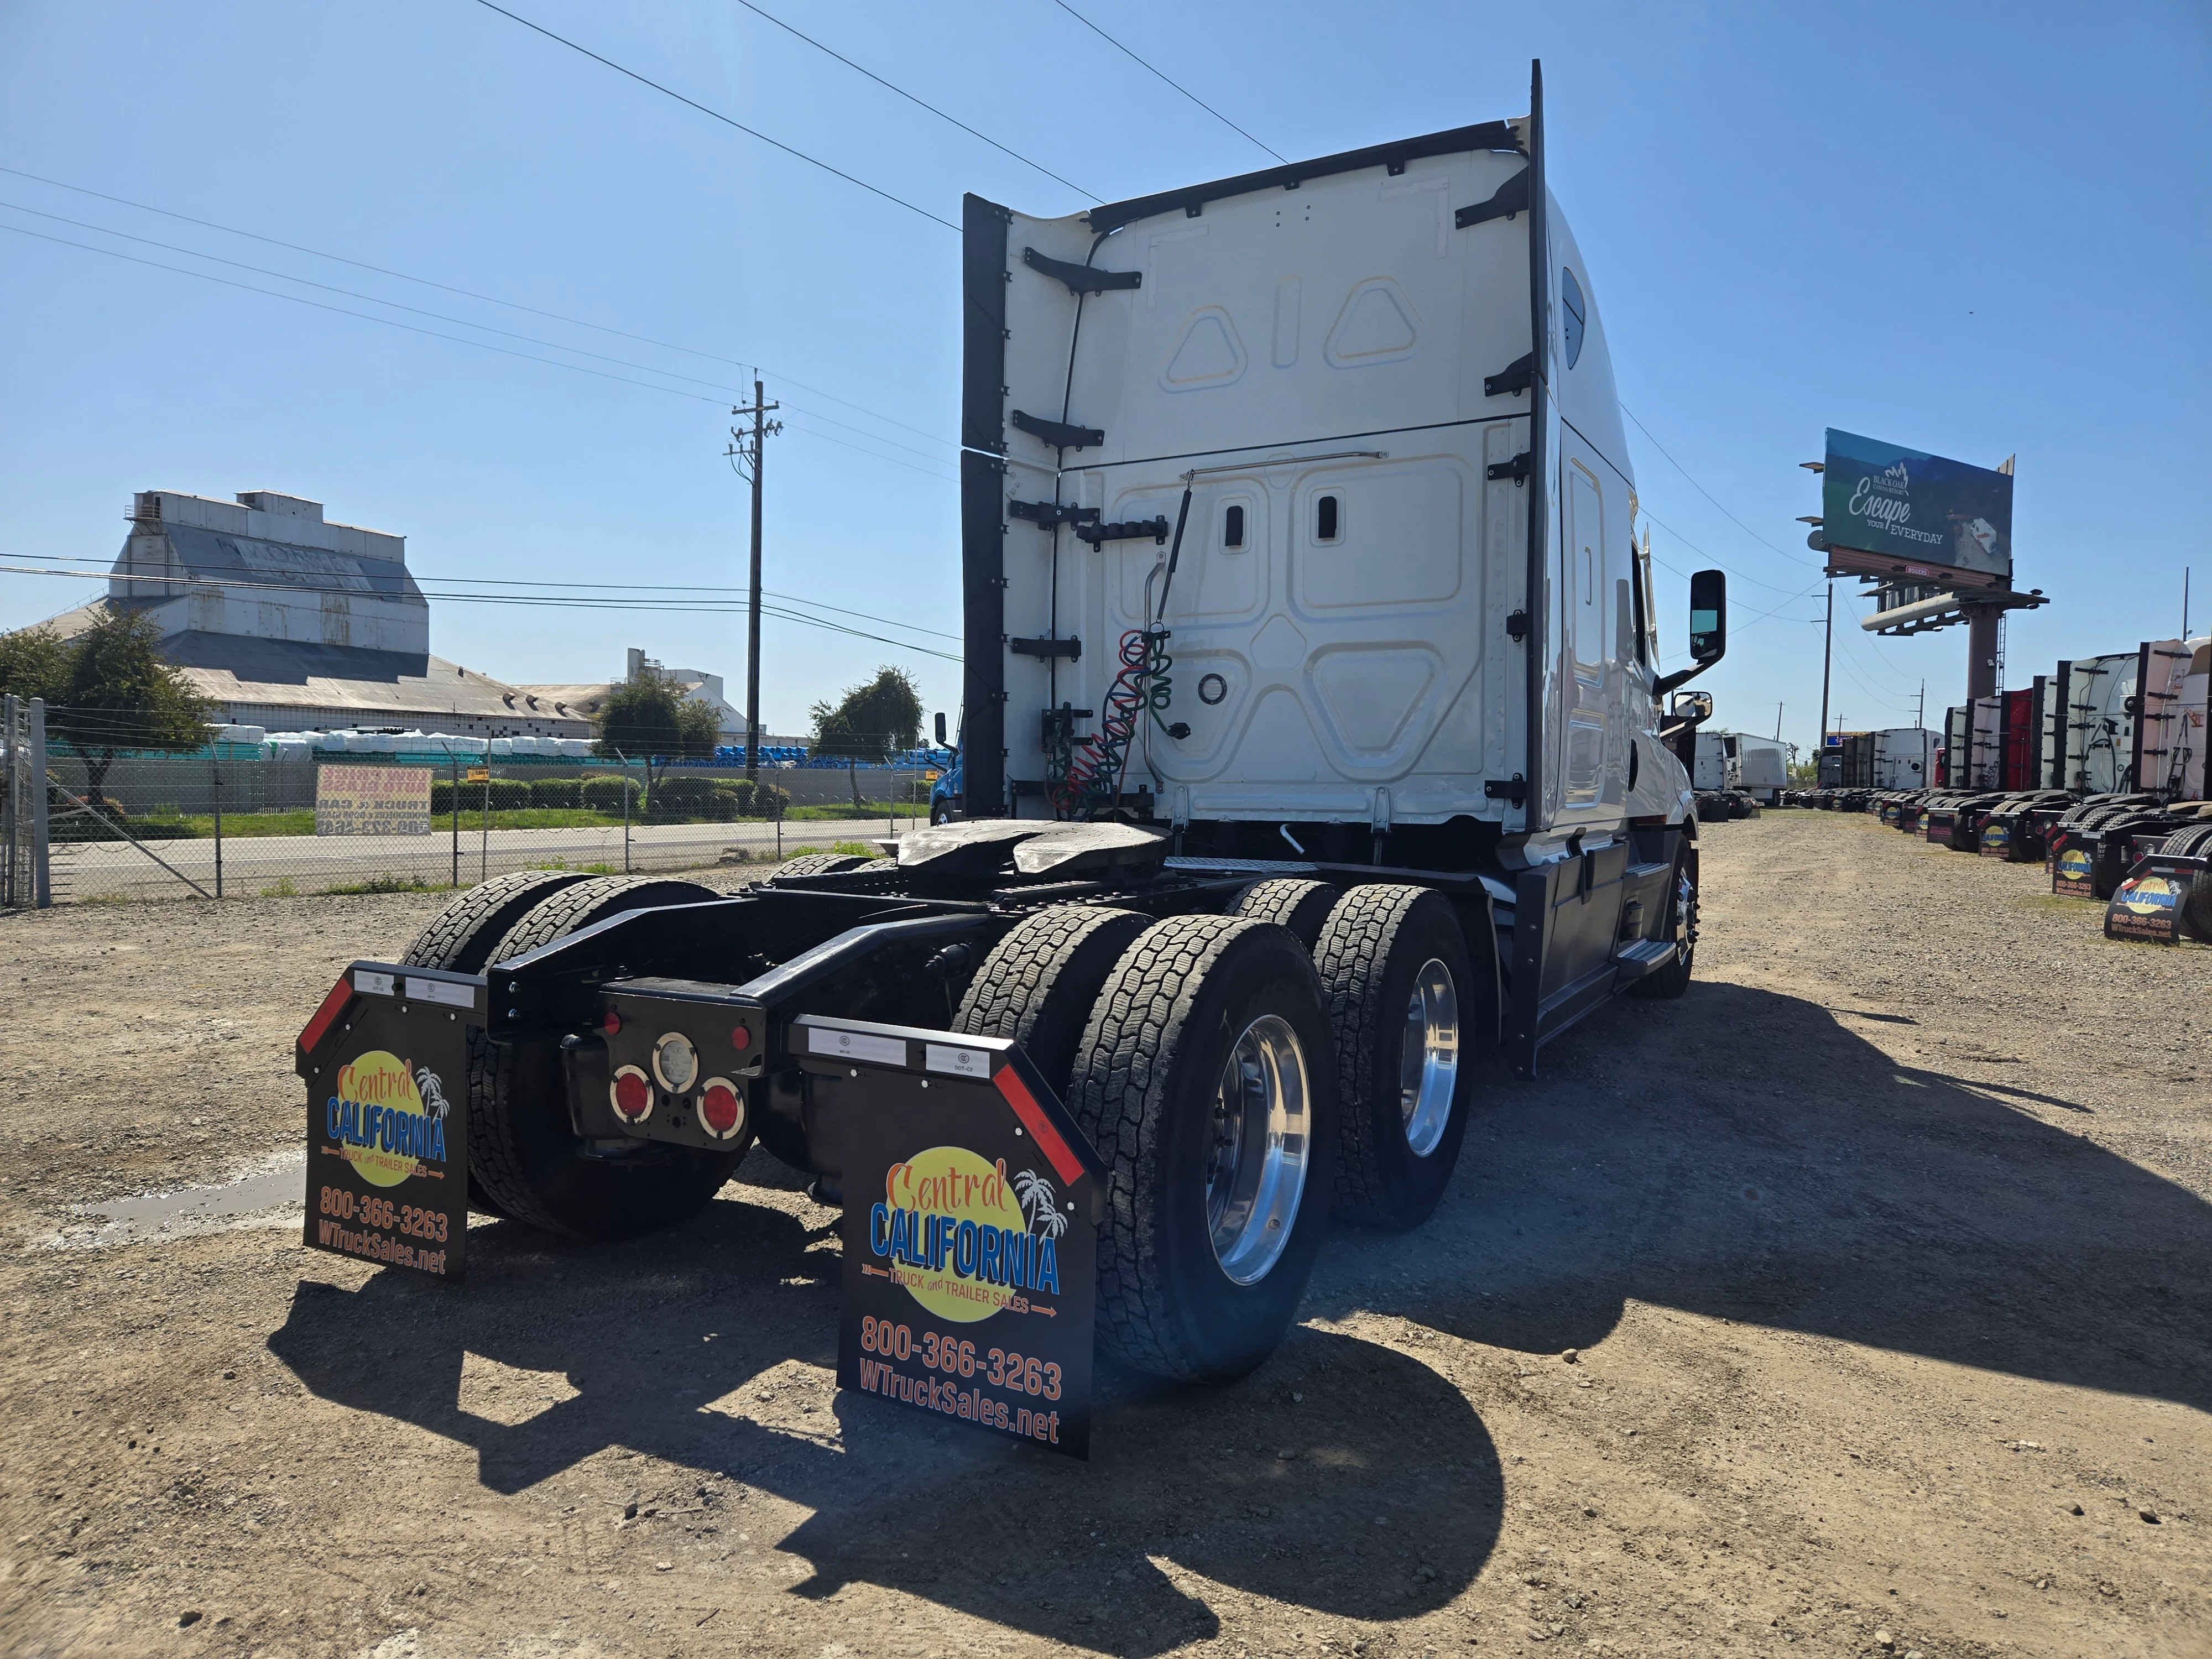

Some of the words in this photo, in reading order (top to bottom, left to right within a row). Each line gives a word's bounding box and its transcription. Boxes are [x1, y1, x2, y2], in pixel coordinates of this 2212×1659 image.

[1849, 477, 1911, 530] Escape
[1874, 476, 1892, 487] BLACK
[1892, 478, 1905, 489] OAK
[1867, 519, 1884, 529] YOUR
[1891, 525, 1943, 544] EVERYDAY
[1908, 567, 1927, 576] ROGERS
[2056, 880, 2091, 890] 800-366-3263
[2058, 860, 2091, 874] CALIFORNIA
[2112, 914, 2172, 929] 800-366-3263
[2121, 890, 2177, 907] CALIFORNIA
[2111, 923, 2172, 938] WTruckSales.net
[337, 1058, 413, 1105] Central
[327, 1096, 446, 1162] CALIFORNIA
[340, 1147, 362, 1164] TRUCK
[364, 1152, 375, 1165] and
[375, 1156, 403, 1172] TRAILER
[404, 1163, 427, 1178] SALES
[886, 1158, 1009, 1214] Central
[320, 1186, 448, 1242] 800-366-3263
[319, 1219, 446, 1275] WTruckSales.net
[870, 1202, 1060, 1295] CALIFORNIA
[889, 1267, 925, 1290] TRUCK
[927, 1275, 943, 1292] and
[946, 1281, 990, 1304] TRAILER
[993, 1292, 1029, 1314] SALES
[861, 1316, 1062, 1401] 800-366-3263
[859, 1357, 1060, 1444] WTruckSales.net
